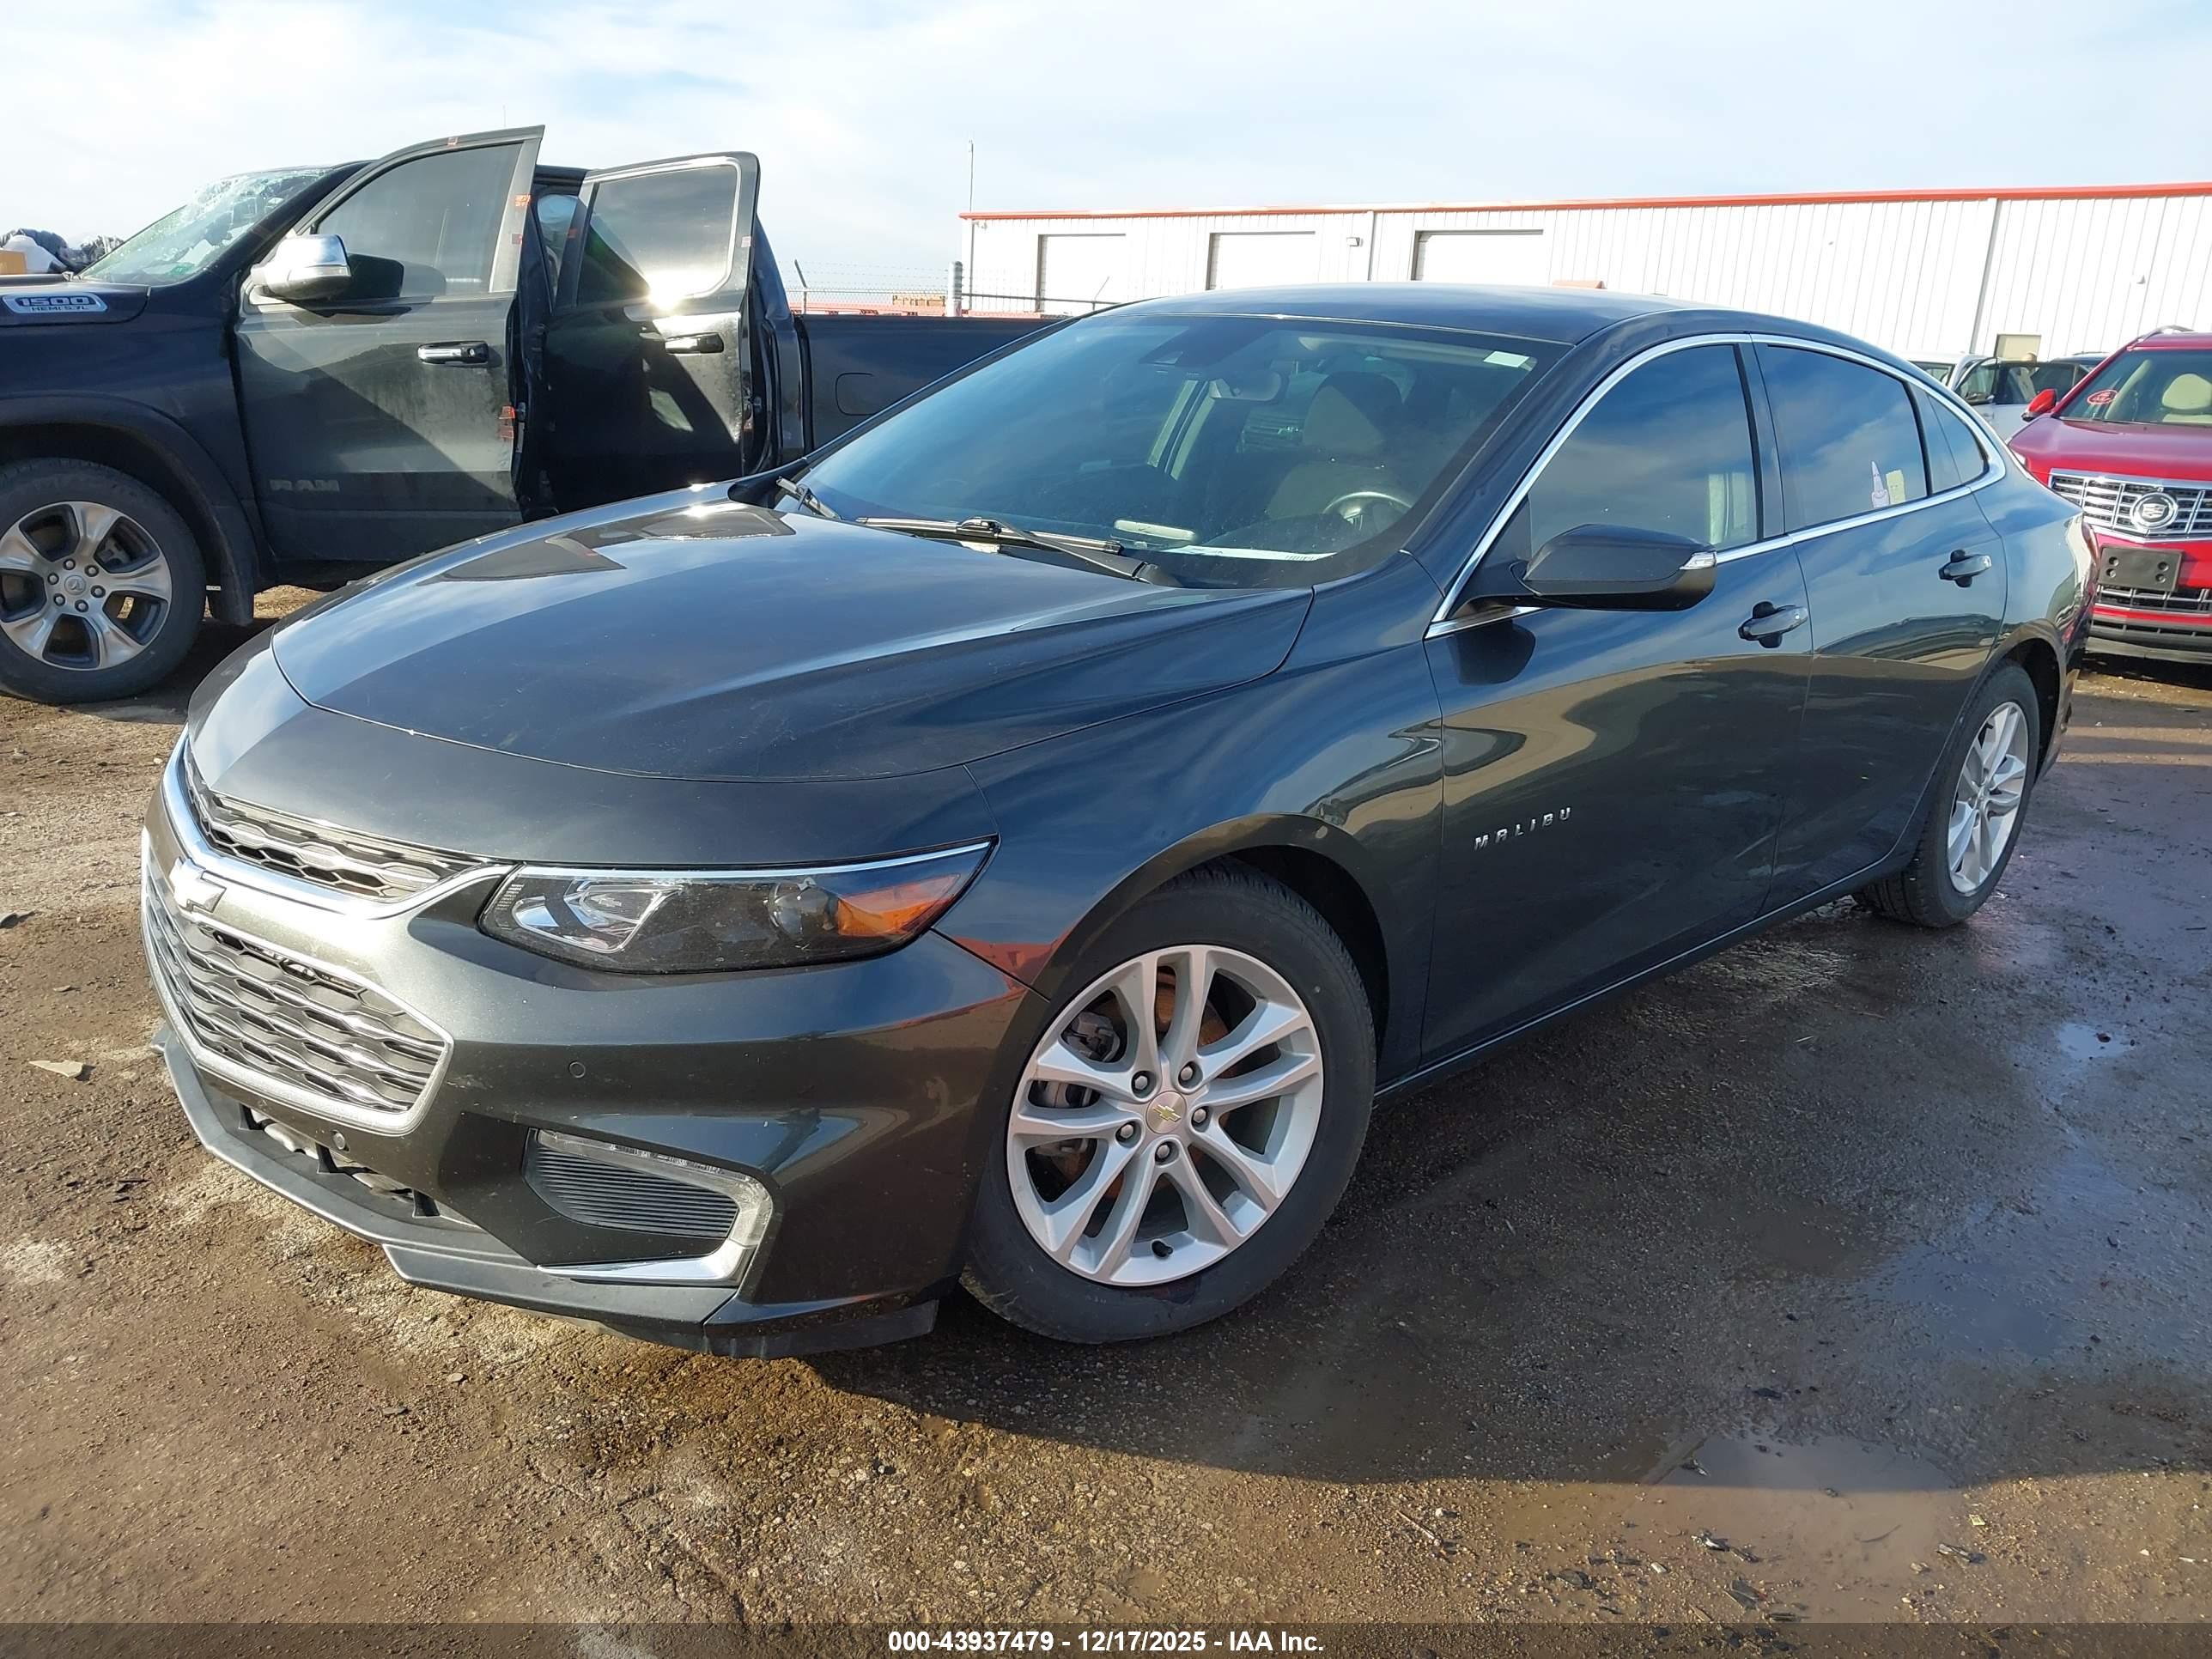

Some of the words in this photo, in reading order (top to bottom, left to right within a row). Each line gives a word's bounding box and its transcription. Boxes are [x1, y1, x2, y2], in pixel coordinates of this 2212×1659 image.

[18, 295, 90, 307] 1500
[269, 479, 340, 492] RAM
[1474, 806, 1571, 851] MALIBU
